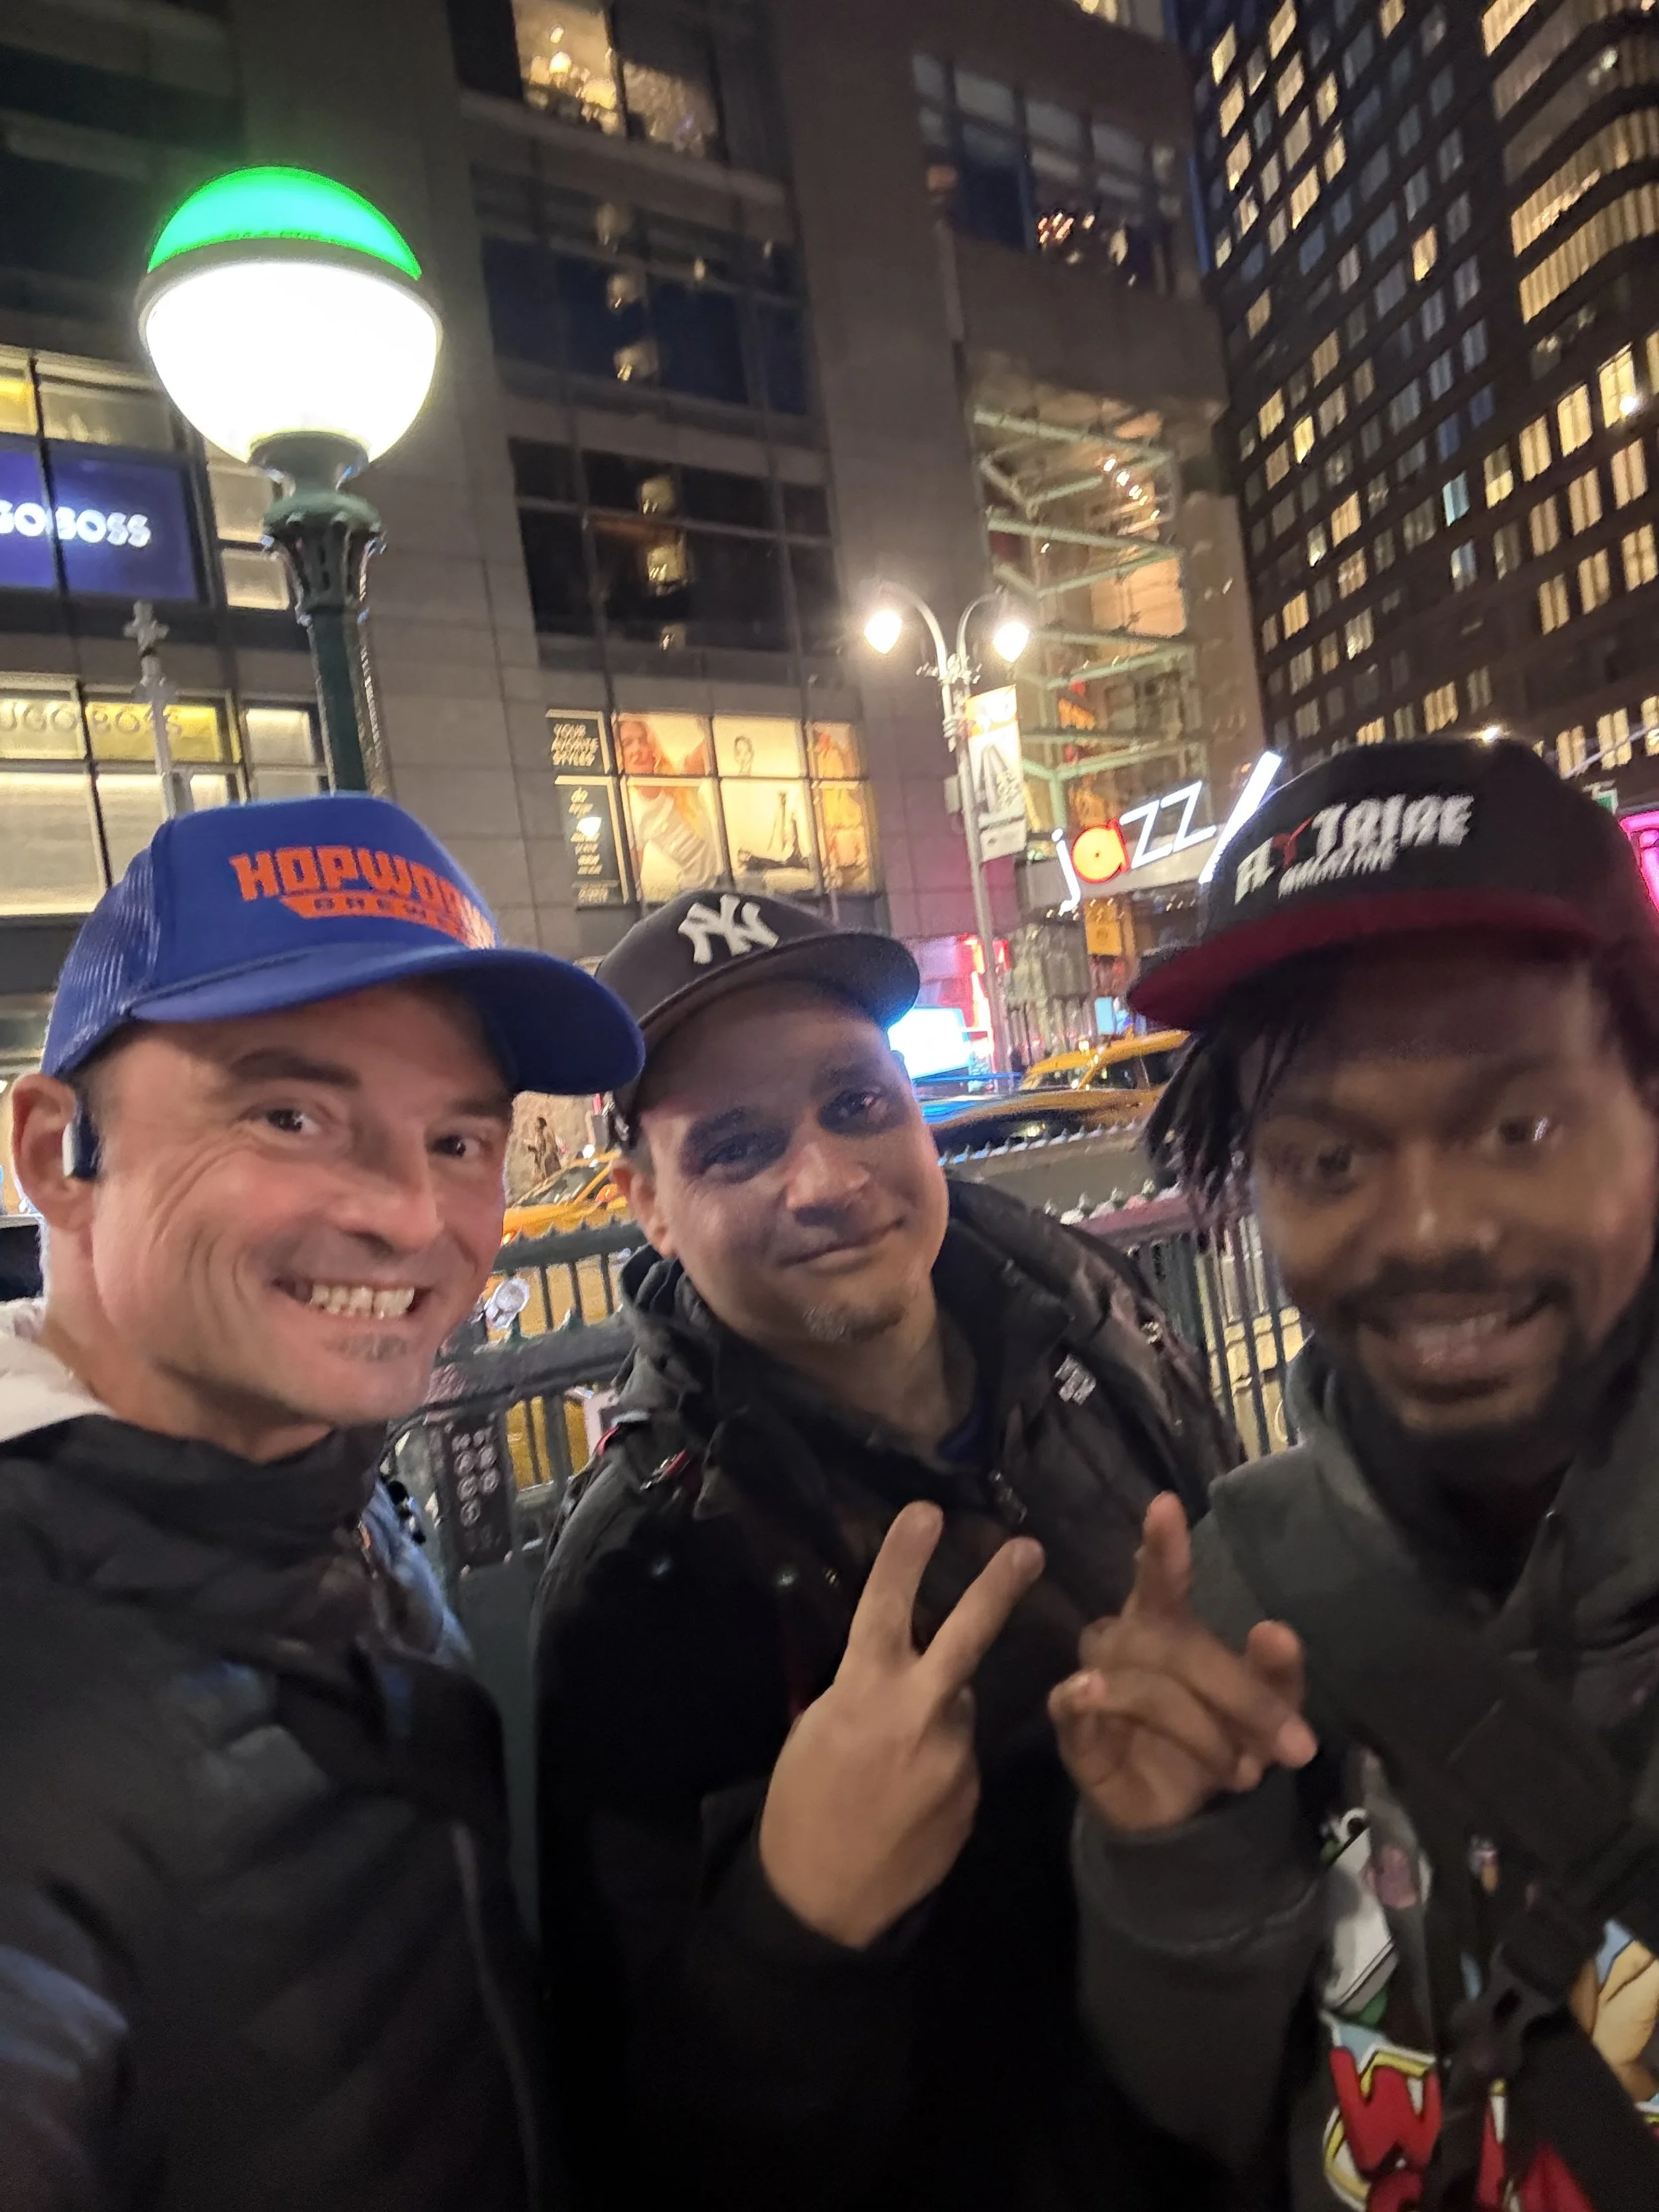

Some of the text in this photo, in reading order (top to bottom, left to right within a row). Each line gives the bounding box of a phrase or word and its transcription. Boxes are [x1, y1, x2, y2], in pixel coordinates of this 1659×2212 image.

[54, 506, 151, 548] BOSS
[1051, 780, 1217, 917] jazz
[678, 894, 780, 964] NY
